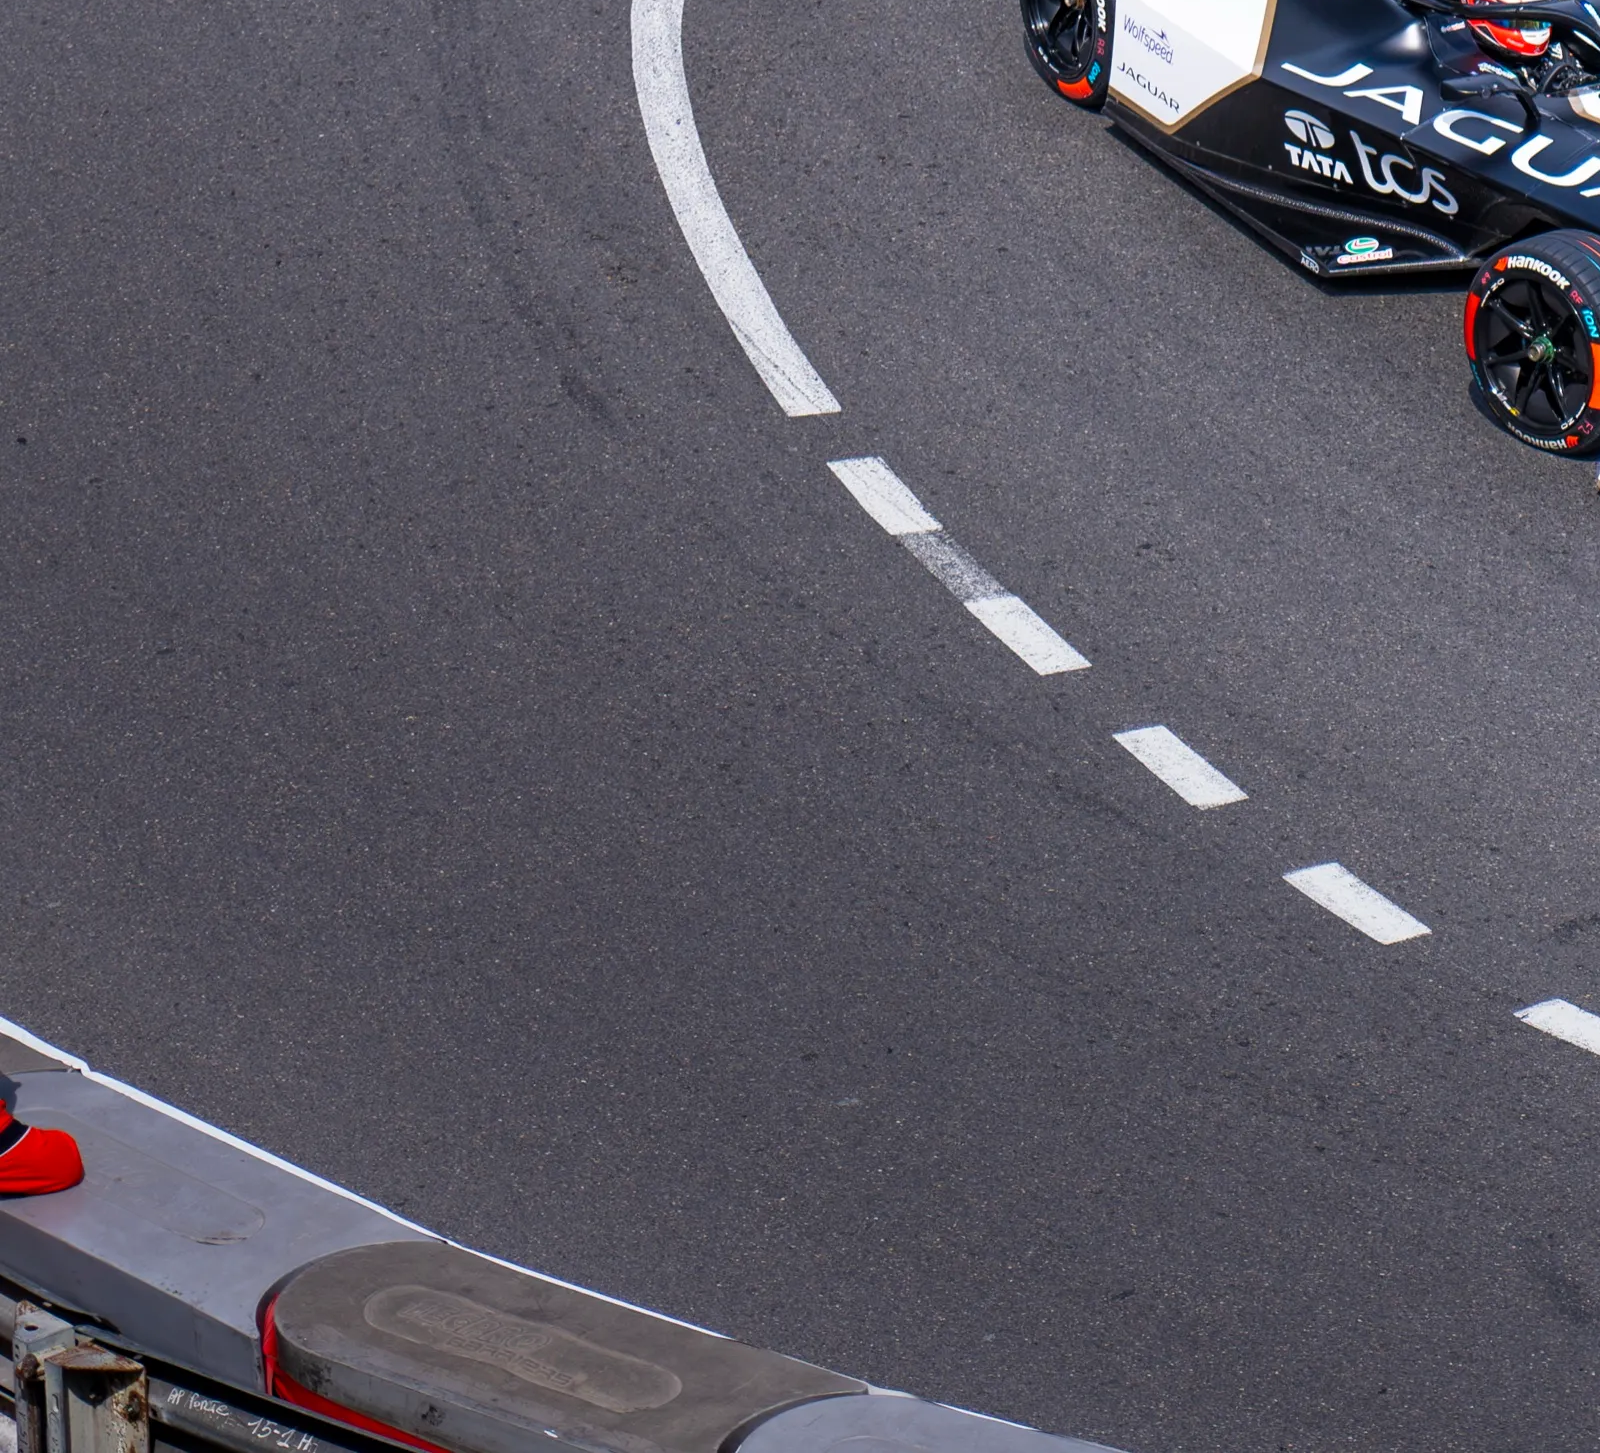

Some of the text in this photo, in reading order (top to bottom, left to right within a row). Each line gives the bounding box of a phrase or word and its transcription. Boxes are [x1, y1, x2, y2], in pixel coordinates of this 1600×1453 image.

[1123, 14, 1174, 64] Wolfspeed
[1117, 62, 1180, 114] JAGUAR
[1284, 143, 1353, 185] TATA
[1350, 130, 1459, 215] tcs
